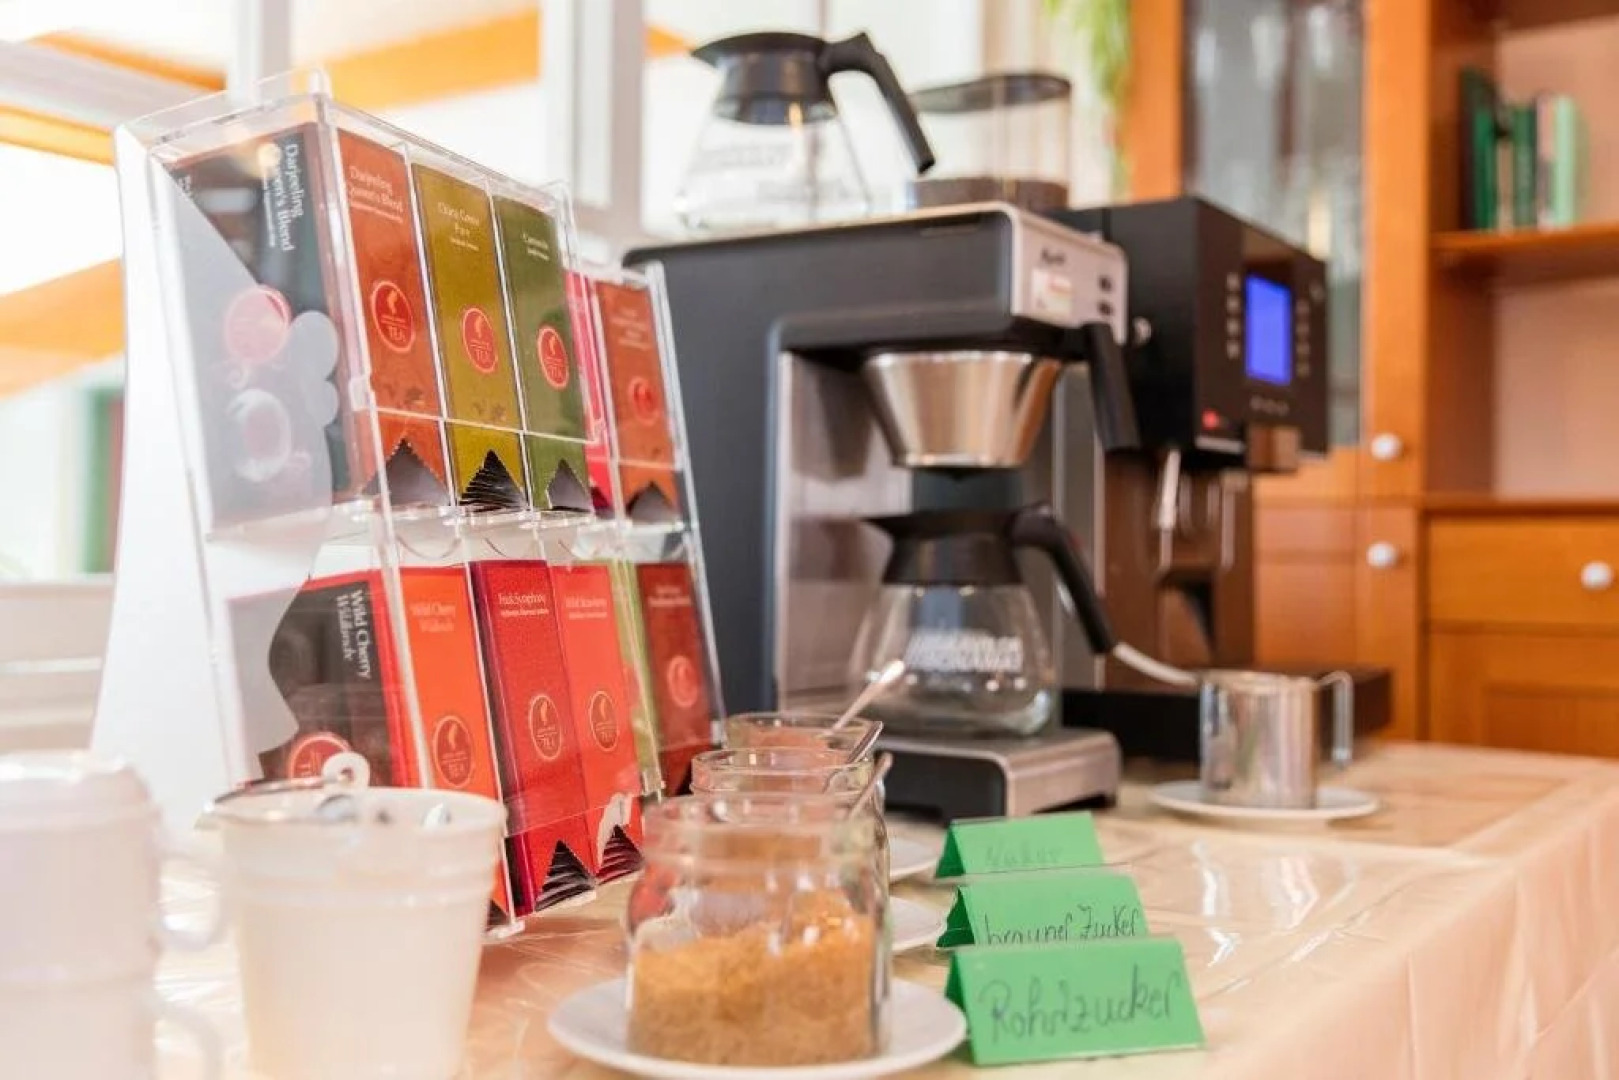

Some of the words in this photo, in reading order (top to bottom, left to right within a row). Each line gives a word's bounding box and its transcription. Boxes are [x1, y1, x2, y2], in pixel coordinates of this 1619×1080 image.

[285, 143, 304, 216] Darjeeling
[278, 209, 297, 251] Blend
[350, 590, 369, 632] Wild
[356, 630, 372, 680] Cherry
[1076, 903, 1140, 940] Zucker
[978, 963, 1182, 1045] Rohrzucker
